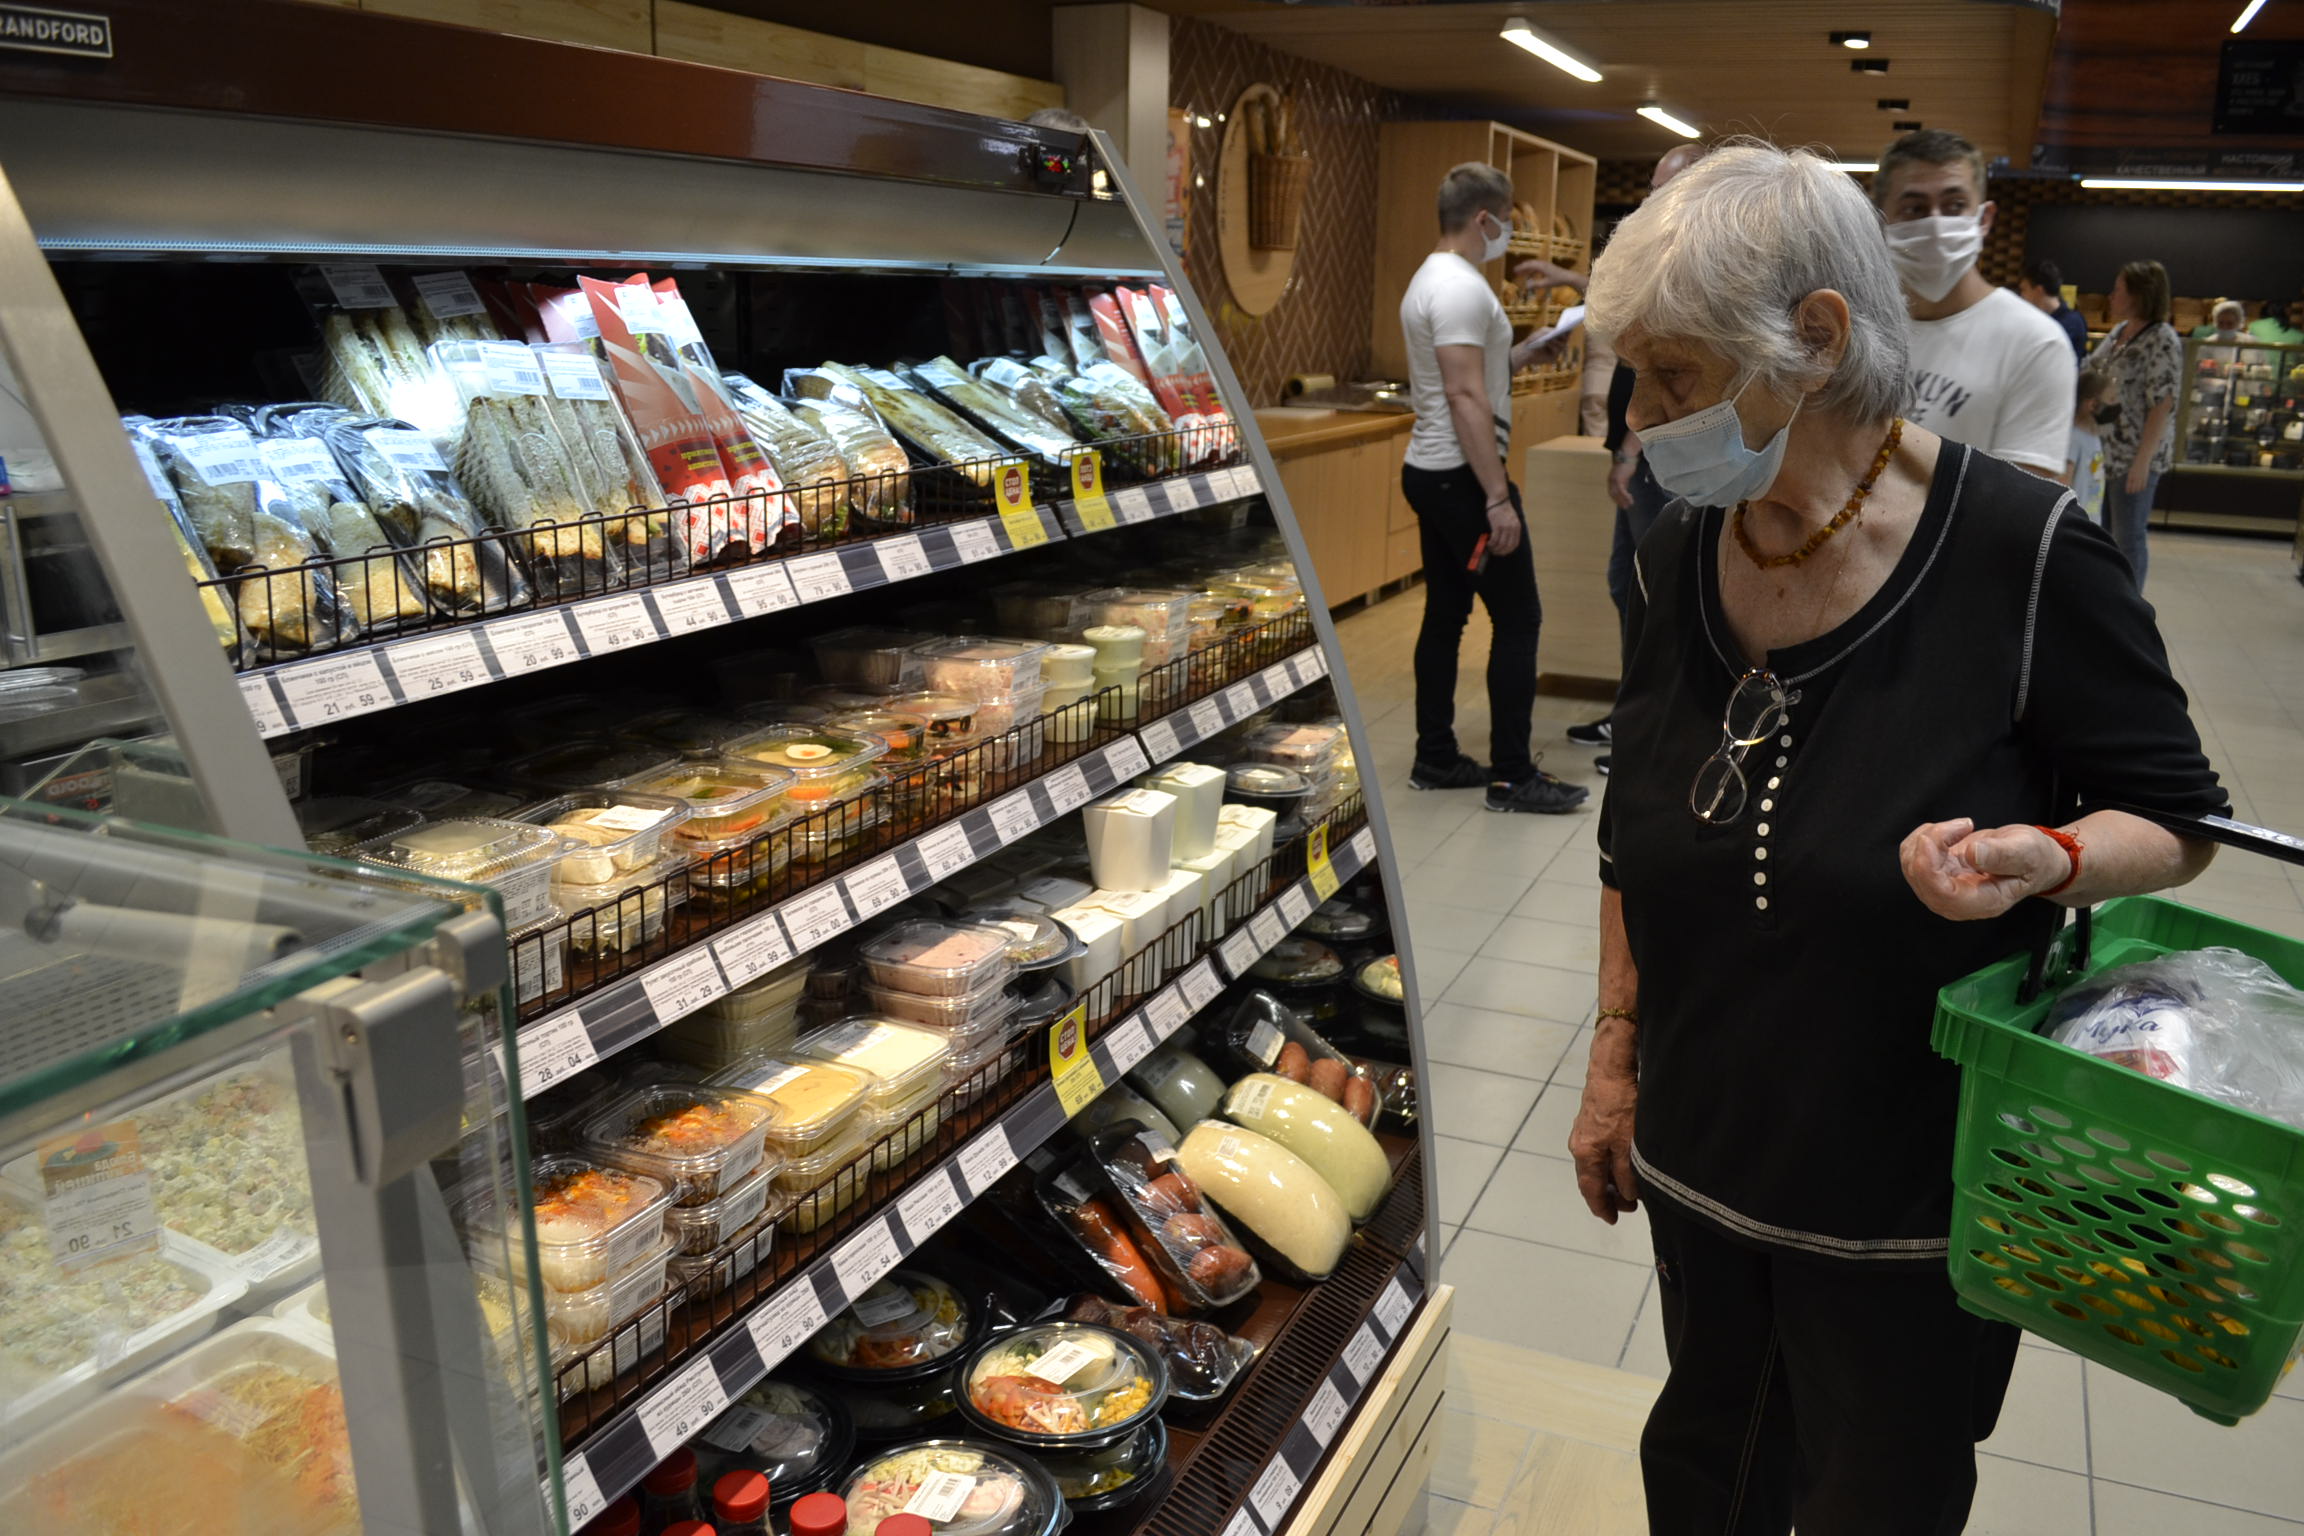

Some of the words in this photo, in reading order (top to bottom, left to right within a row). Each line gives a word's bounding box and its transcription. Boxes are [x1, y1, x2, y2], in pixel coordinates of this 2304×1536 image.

[1909, 369, 1972, 418] KLYN
[684, 616, 697, 627] 44
[606, 634, 620, 647] 49
[631, 628, 645, 640] 90
[522, 653, 538, 667] 20
[549, 646, 565, 660] 99
[427, 676, 444, 690] 25
[458, 669, 474, 682] 59
[323, 701, 340, 715] 21
[357, 693, 376, 707] 59
[809, 928, 821, 940] 79
[829, 918, 840, 930] 00
[745, 961, 757, 975] 30
[766, 949, 779, 963] 99
[674, 996, 689, 1011] 31
[699, 984, 713, 998] 29
[538, 1065, 553, 1084] 28
[567, 1051, 582, 1068] 04
[982, 1169, 992, 1182] 12
[924, 1216, 935, 1231] 12
[941, 1202, 953, 1217] 99
[860, 1269, 872, 1284] 12
[879, 1253, 891, 1268] 54
[779, 1333, 793, 1350] 49
[801, 1315, 814, 1332] 90
[673, 1419, 689, 1439] 49
[700, 1398, 714, 1417] 90
[573, 1503, 589, 1521] 90
